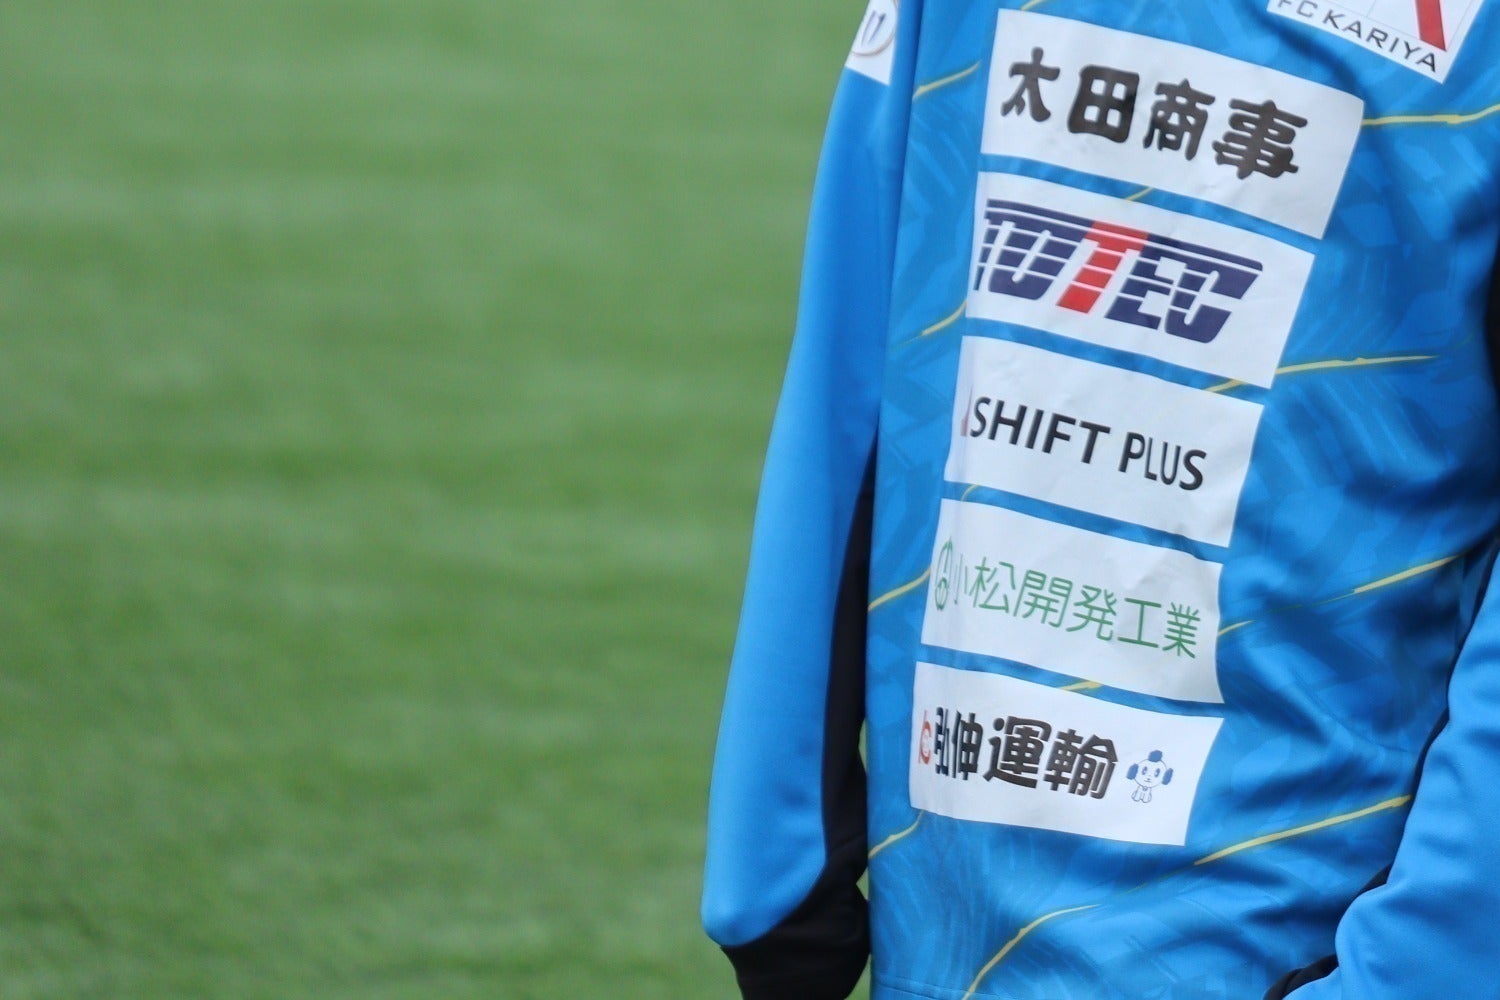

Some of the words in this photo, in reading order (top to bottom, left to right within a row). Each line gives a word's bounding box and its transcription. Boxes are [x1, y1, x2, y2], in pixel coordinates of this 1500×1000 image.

[1323, 10, 1437, 73] KARIYA
[1000, 46, 1308, 180] 太田商事
[970, 396, 1112, 465] SHIFT
[1118, 432, 1208, 491] PLUS
[954, 553, 1201, 658] 小松開発工業
